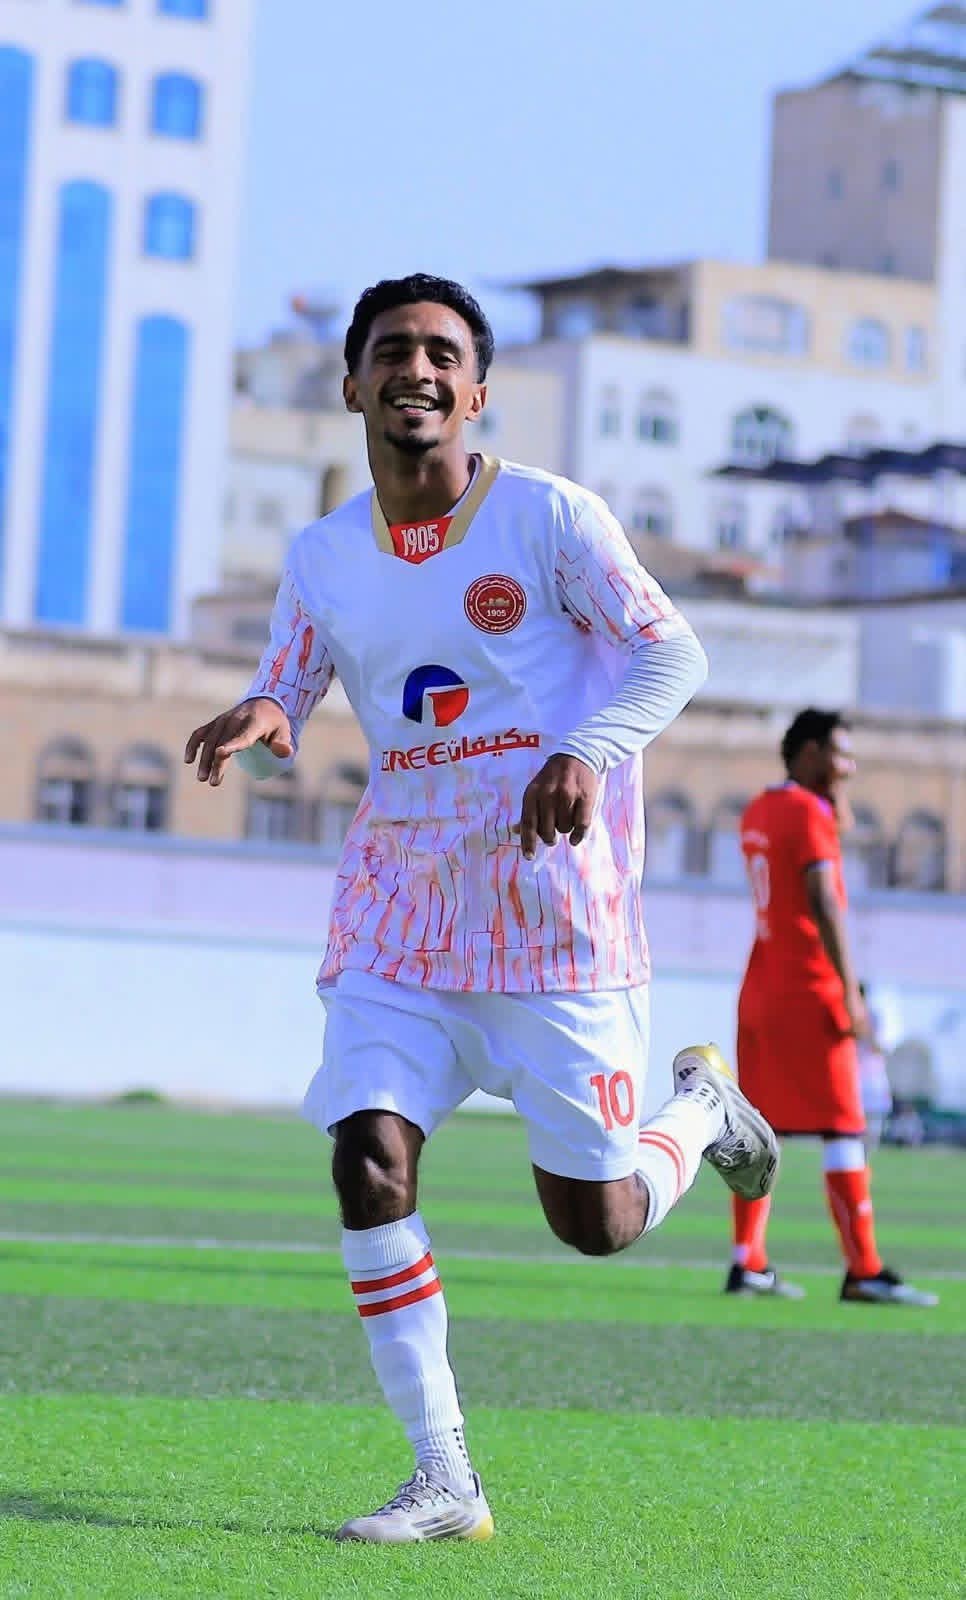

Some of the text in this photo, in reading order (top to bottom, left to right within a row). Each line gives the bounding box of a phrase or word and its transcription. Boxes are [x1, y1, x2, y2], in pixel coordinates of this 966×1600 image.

[400, 524, 439, 556] 1905
[487, 609, 507, 617] 1905
[447, 728, 540, 762] مكيفات
[590, 1070, 634, 1131] 10
